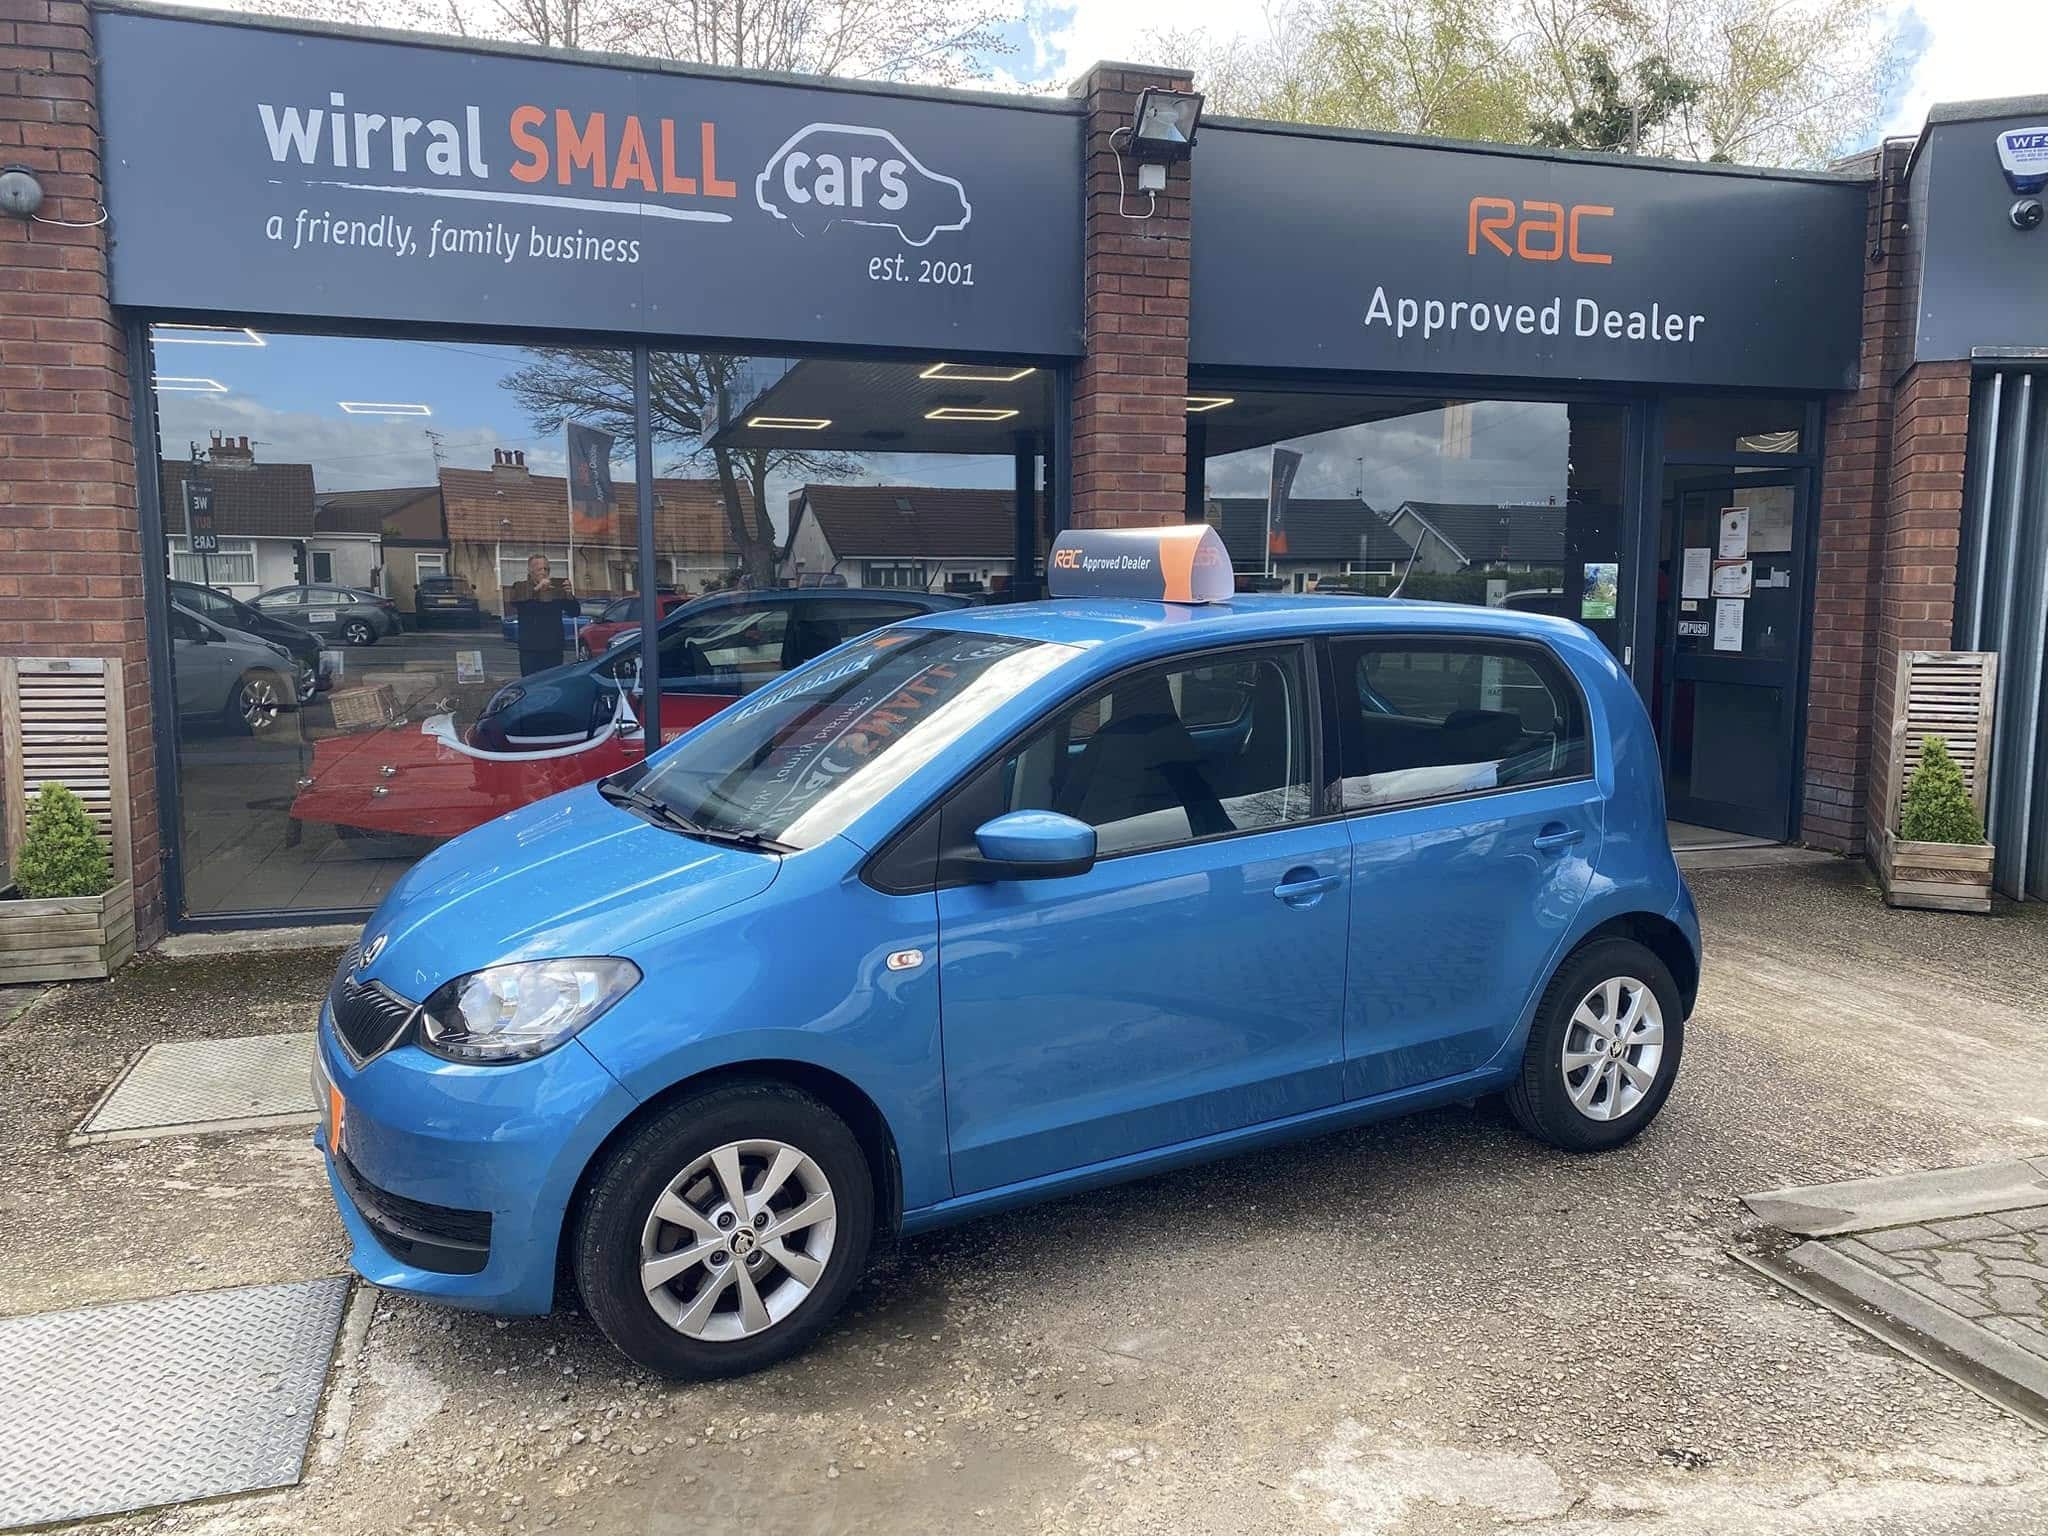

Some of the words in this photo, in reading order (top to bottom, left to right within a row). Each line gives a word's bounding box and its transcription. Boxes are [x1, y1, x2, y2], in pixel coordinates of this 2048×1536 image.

[258, 92, 488, 178] wirral
[510, 105, 737, 198] SMALL
[783, 151, 909, 211] cars
[265, 214, 283, 240] a
[293, 209, 418, 257] friendly,
[429, 219, 521, 263] family
[528, 226, 641, 263] business
[868, 254, 909, 283] est.
[918, 260, 975, 287] 2001
[1364, 286, 1561, 340] Approved
[1574, 298, 1706, 342] Dealer
[1083, 555, 1120, 572] Approved
[1121, 555, 1151, 570] Dealer
[1688, 623, 1707, 634] PUSH
